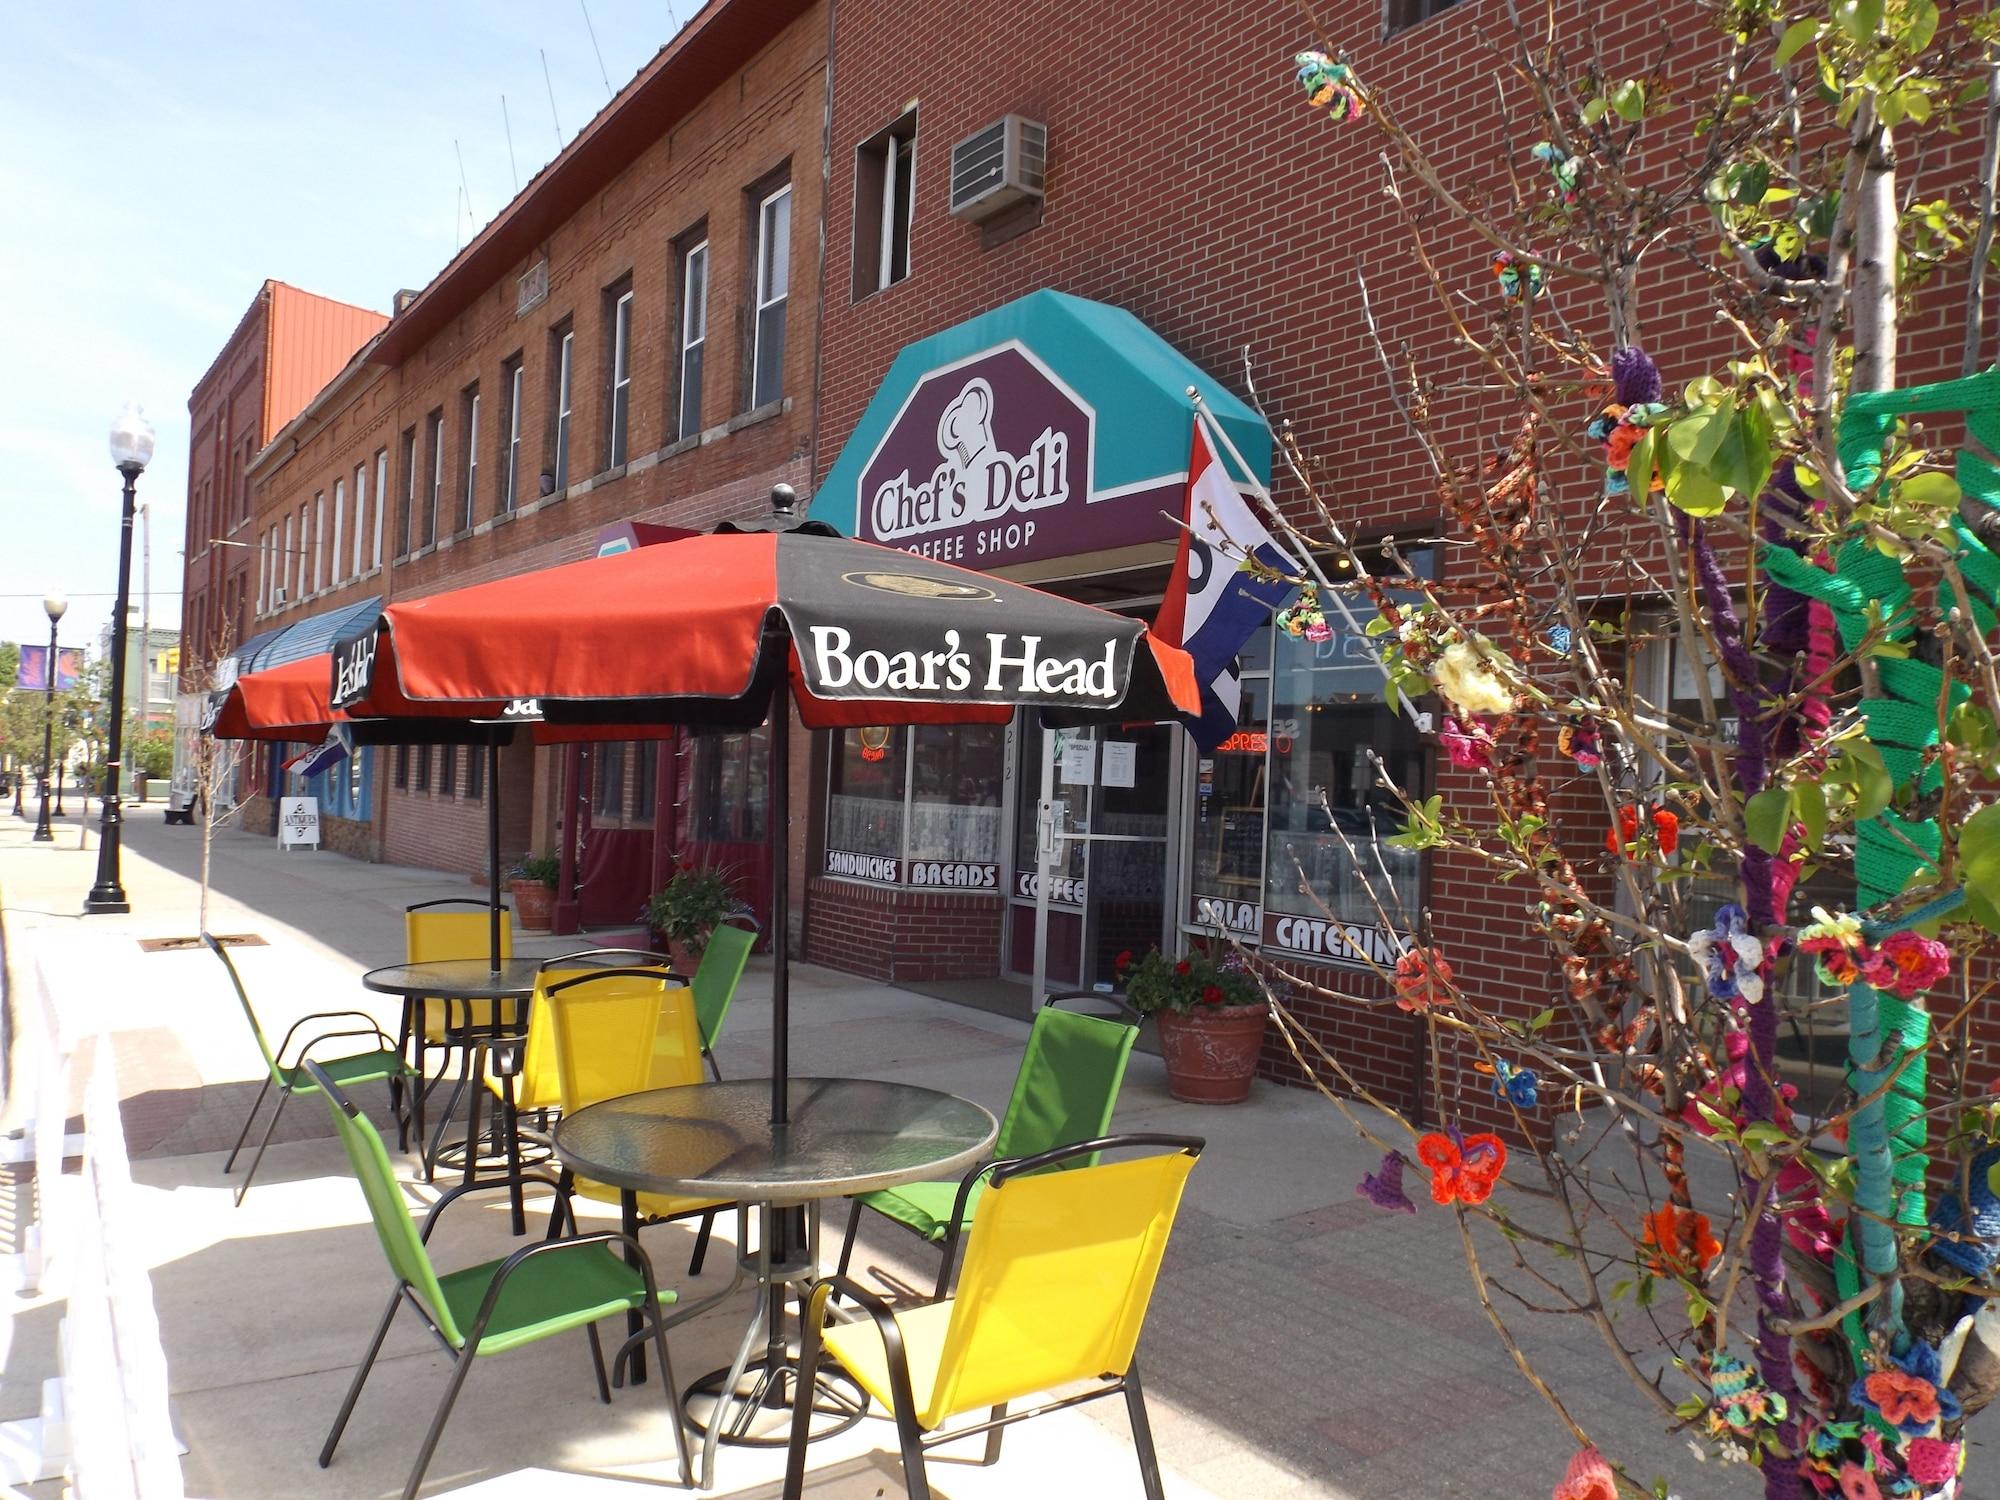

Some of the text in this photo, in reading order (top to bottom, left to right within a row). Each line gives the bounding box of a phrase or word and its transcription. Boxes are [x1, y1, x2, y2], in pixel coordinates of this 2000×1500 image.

[875, 441, 1063, 534] Chef's Deli
[976, 520, 1036, 555] SHOP
[809, 625, 1118, 698] Boar's Head
[828, 851, 996, 887] SANDWICHES BREADS
